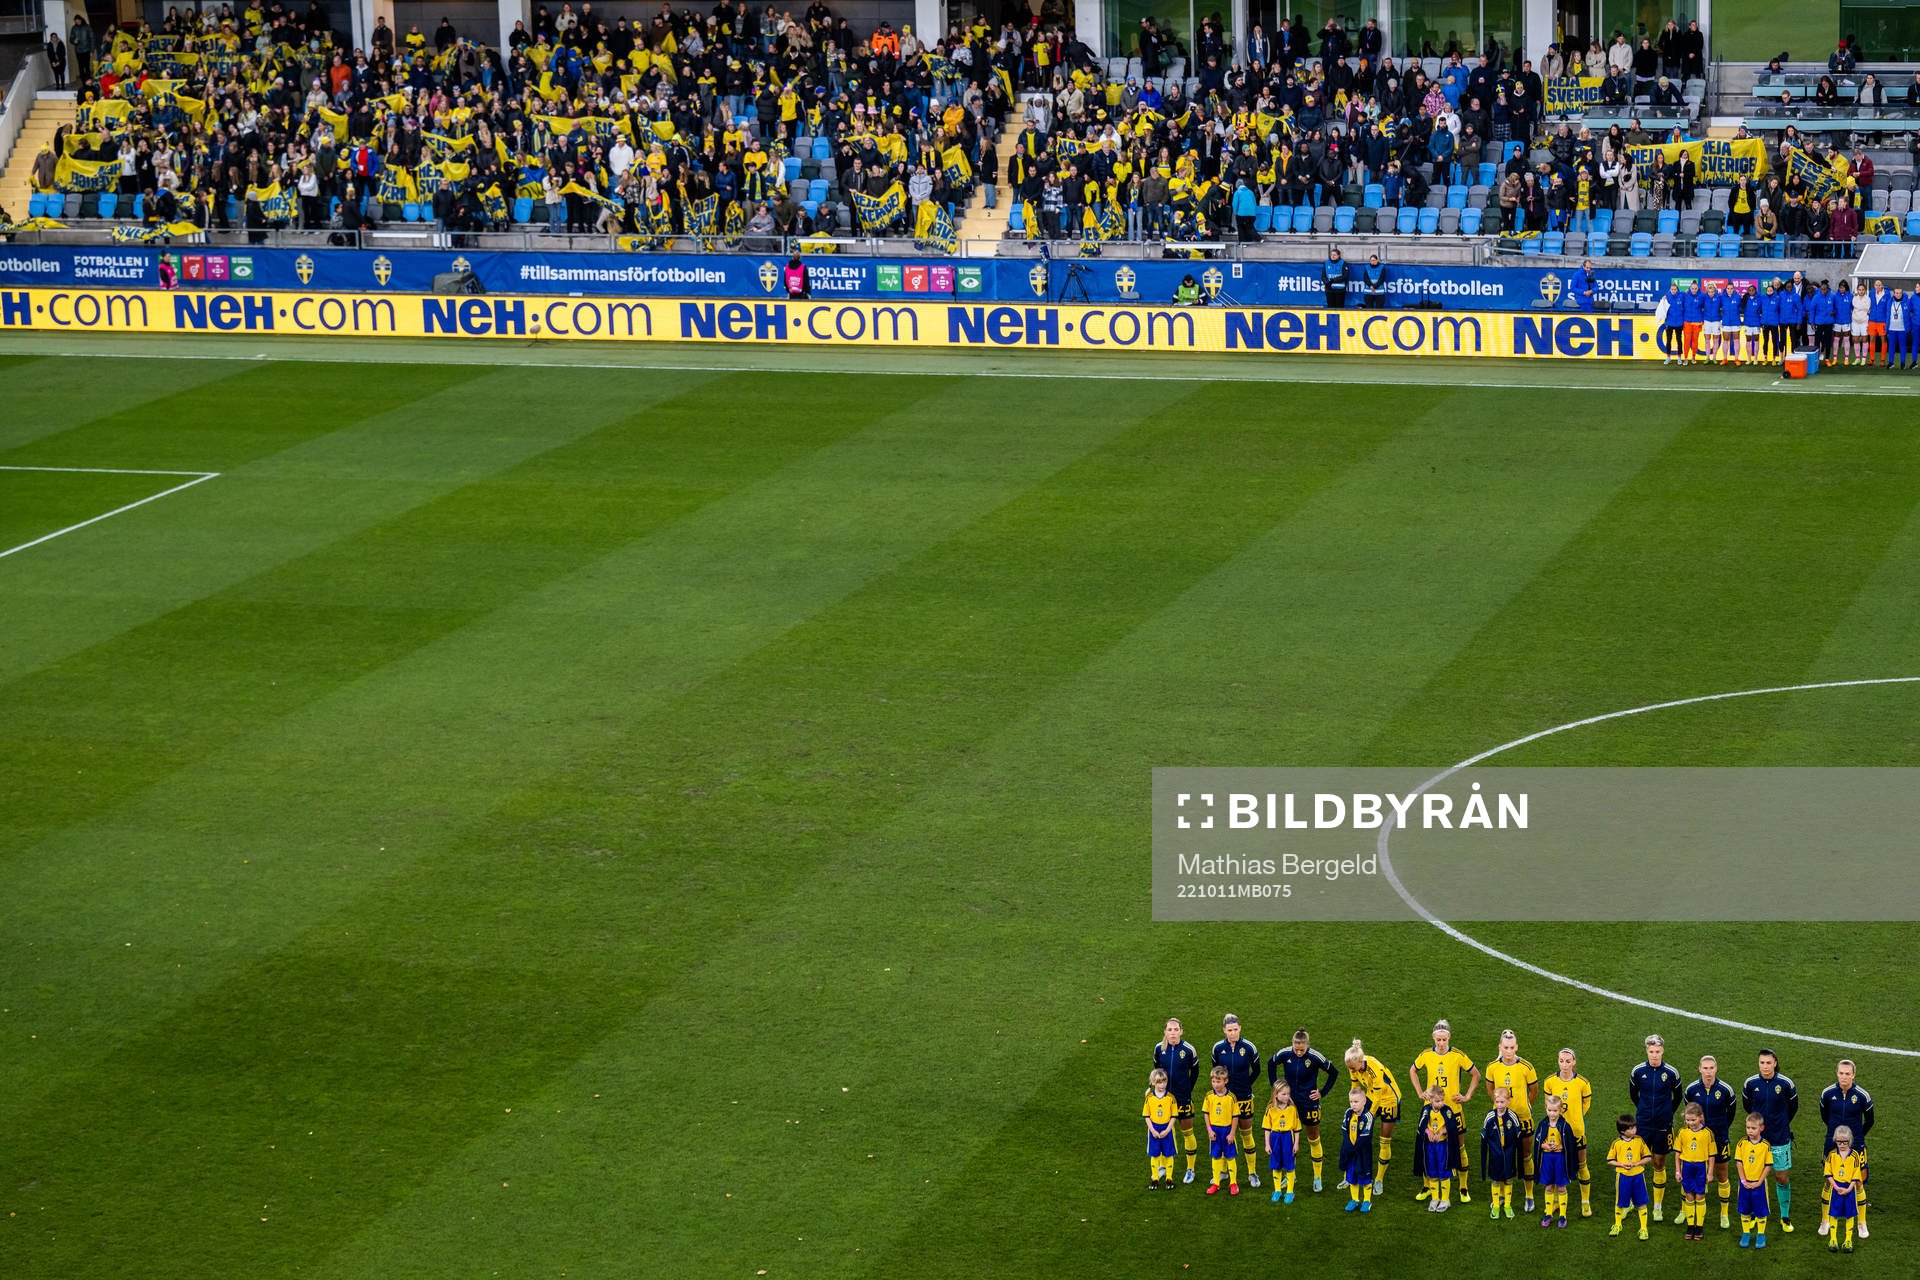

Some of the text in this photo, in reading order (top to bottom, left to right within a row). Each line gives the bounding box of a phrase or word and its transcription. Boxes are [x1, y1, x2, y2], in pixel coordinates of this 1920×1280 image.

[0, 258, 60, 273] otbollen
[74, 256, 149, 267] FOTBOLLEN I
[75, 266, 145, 279] SAMHÄLLET
[520, 264, 726, 284] #tillsammansförfotbollen
[808, 267, 860, 278] BOLLEN
[862, 268, 867, 278] I
[811, 277, 862, 290] HÄLLET
[1655, 280, 1659, 291] I
[1435, 1076, 1448, 1088] 13
